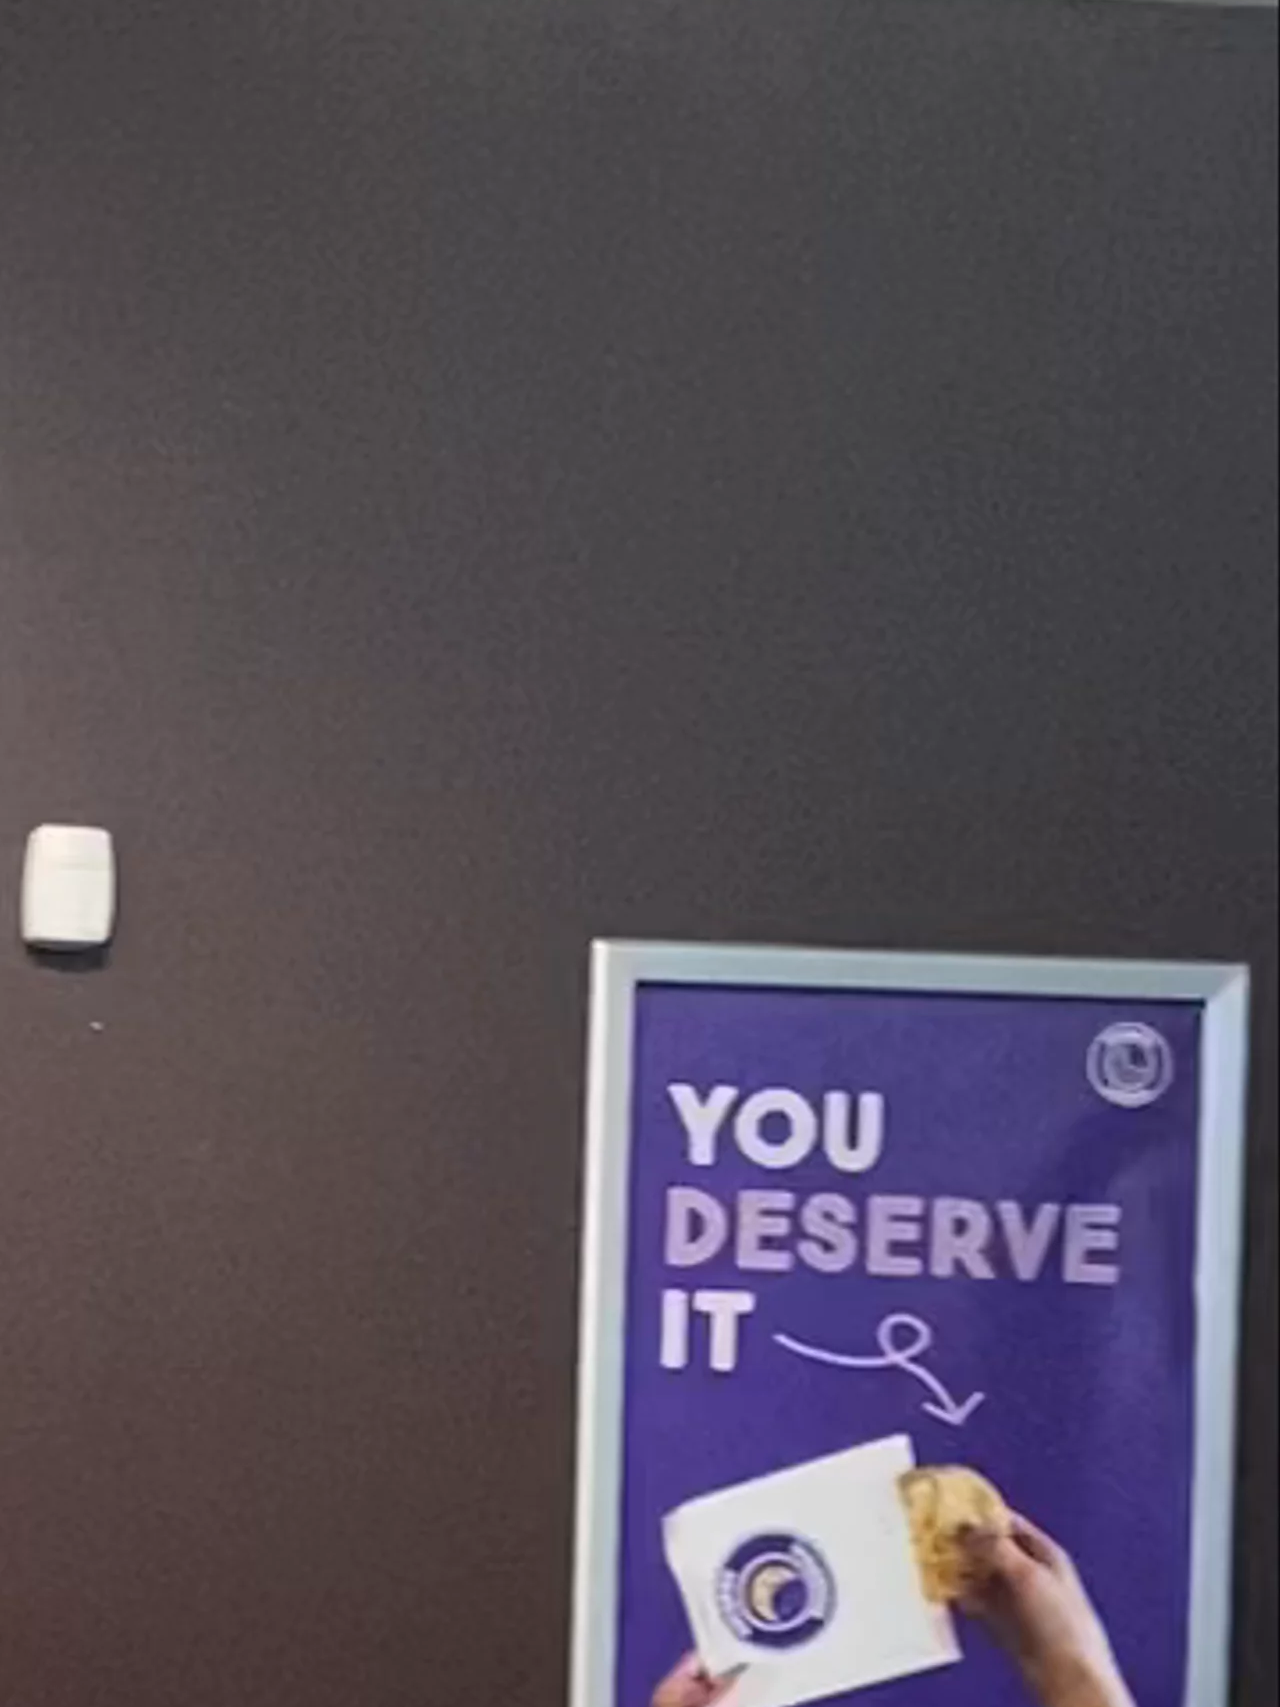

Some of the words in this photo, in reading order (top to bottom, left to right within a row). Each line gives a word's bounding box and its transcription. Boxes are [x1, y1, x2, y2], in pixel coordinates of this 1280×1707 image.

[667, 1083, 885, 1173] YOU
[664, 1186, 1122, 1285] DESERVE
[659, 1289, 757, 1372] IT
